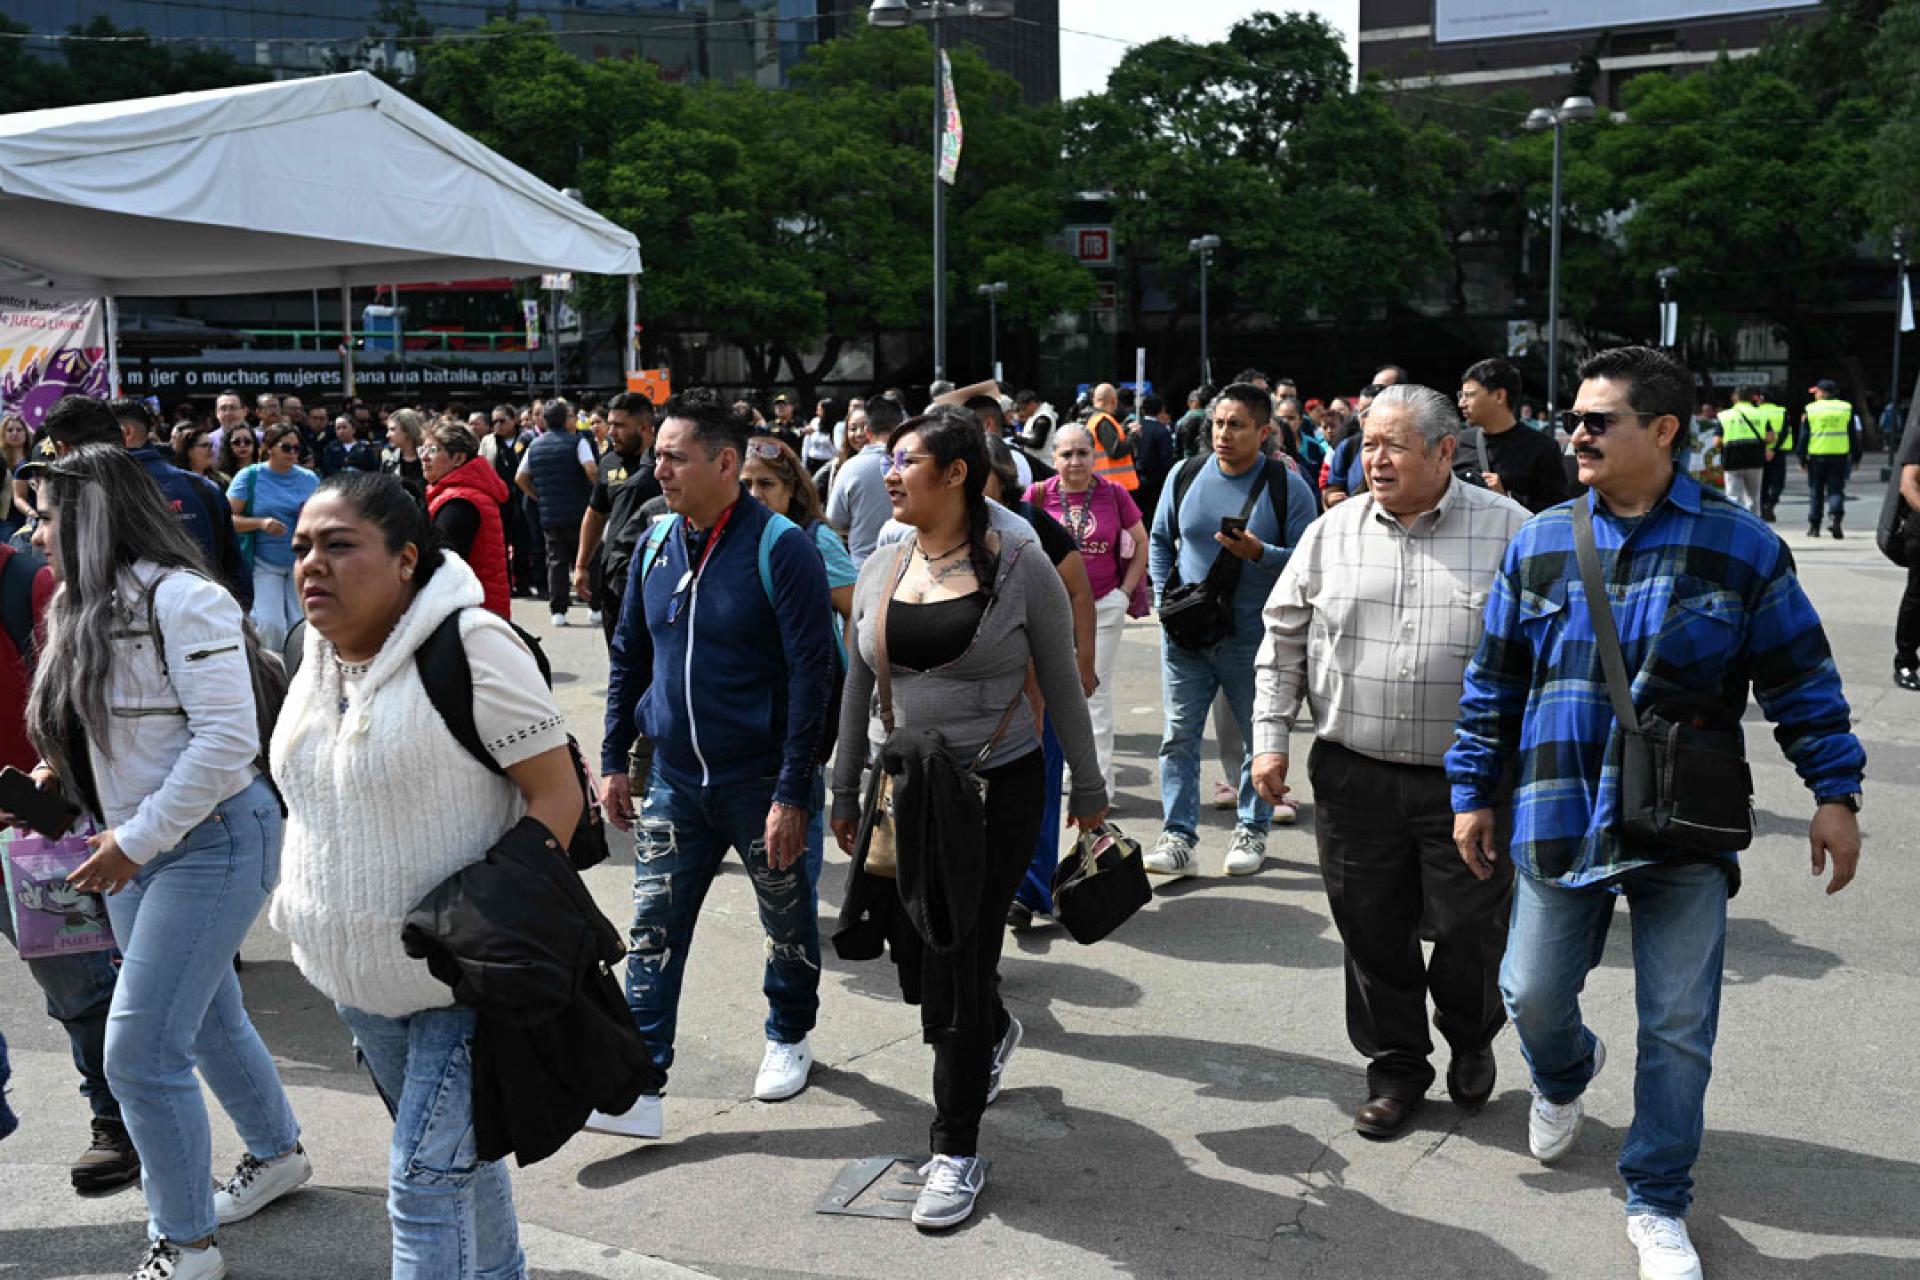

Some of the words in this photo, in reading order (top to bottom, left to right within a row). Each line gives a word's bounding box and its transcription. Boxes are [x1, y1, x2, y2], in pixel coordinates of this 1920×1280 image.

[185, 371, 198, 385] o
[202, 368, 269, 385] muchas
[273, 368, 341, 387] mujeres
[355, 371, 385, 383] ana
[390, 371, 419, 383] una
[423, 368, 478, 383] batalla
[483, 371, 518, 385] para
